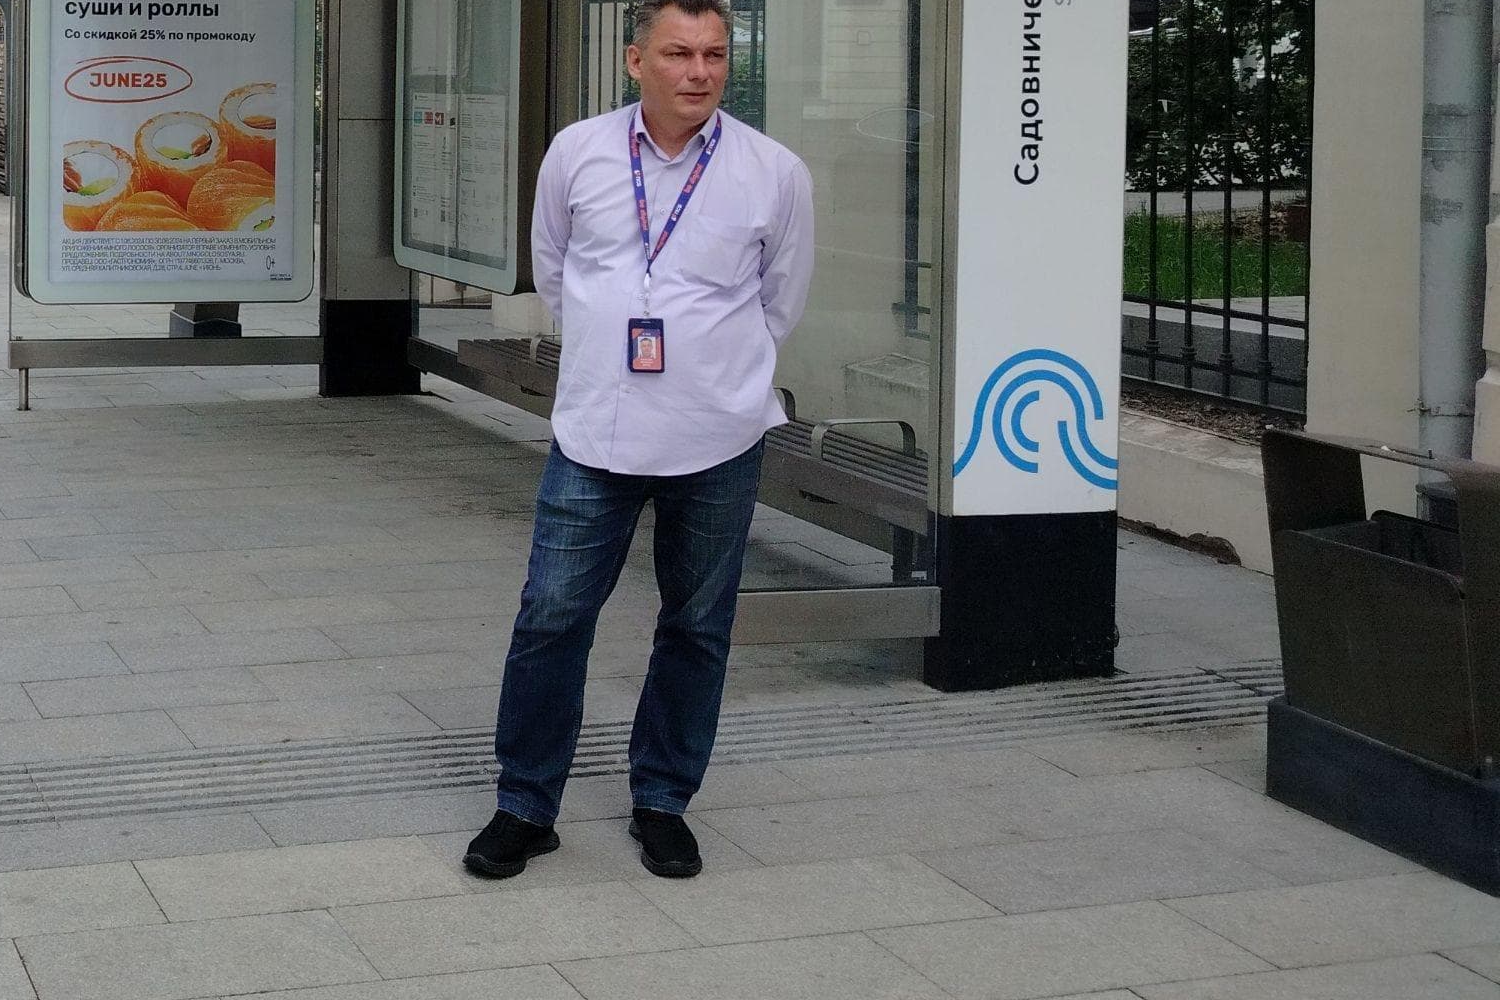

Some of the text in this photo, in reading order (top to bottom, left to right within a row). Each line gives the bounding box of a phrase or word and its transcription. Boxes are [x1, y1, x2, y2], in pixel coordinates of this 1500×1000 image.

[65, 1, 219, 20] суши и роллы
[64, 28, 257, 43] Со скидкой 25% по промокоду
[89, 72, 168, 88] JUNE25
[265, 254, 276, 271] 0+
